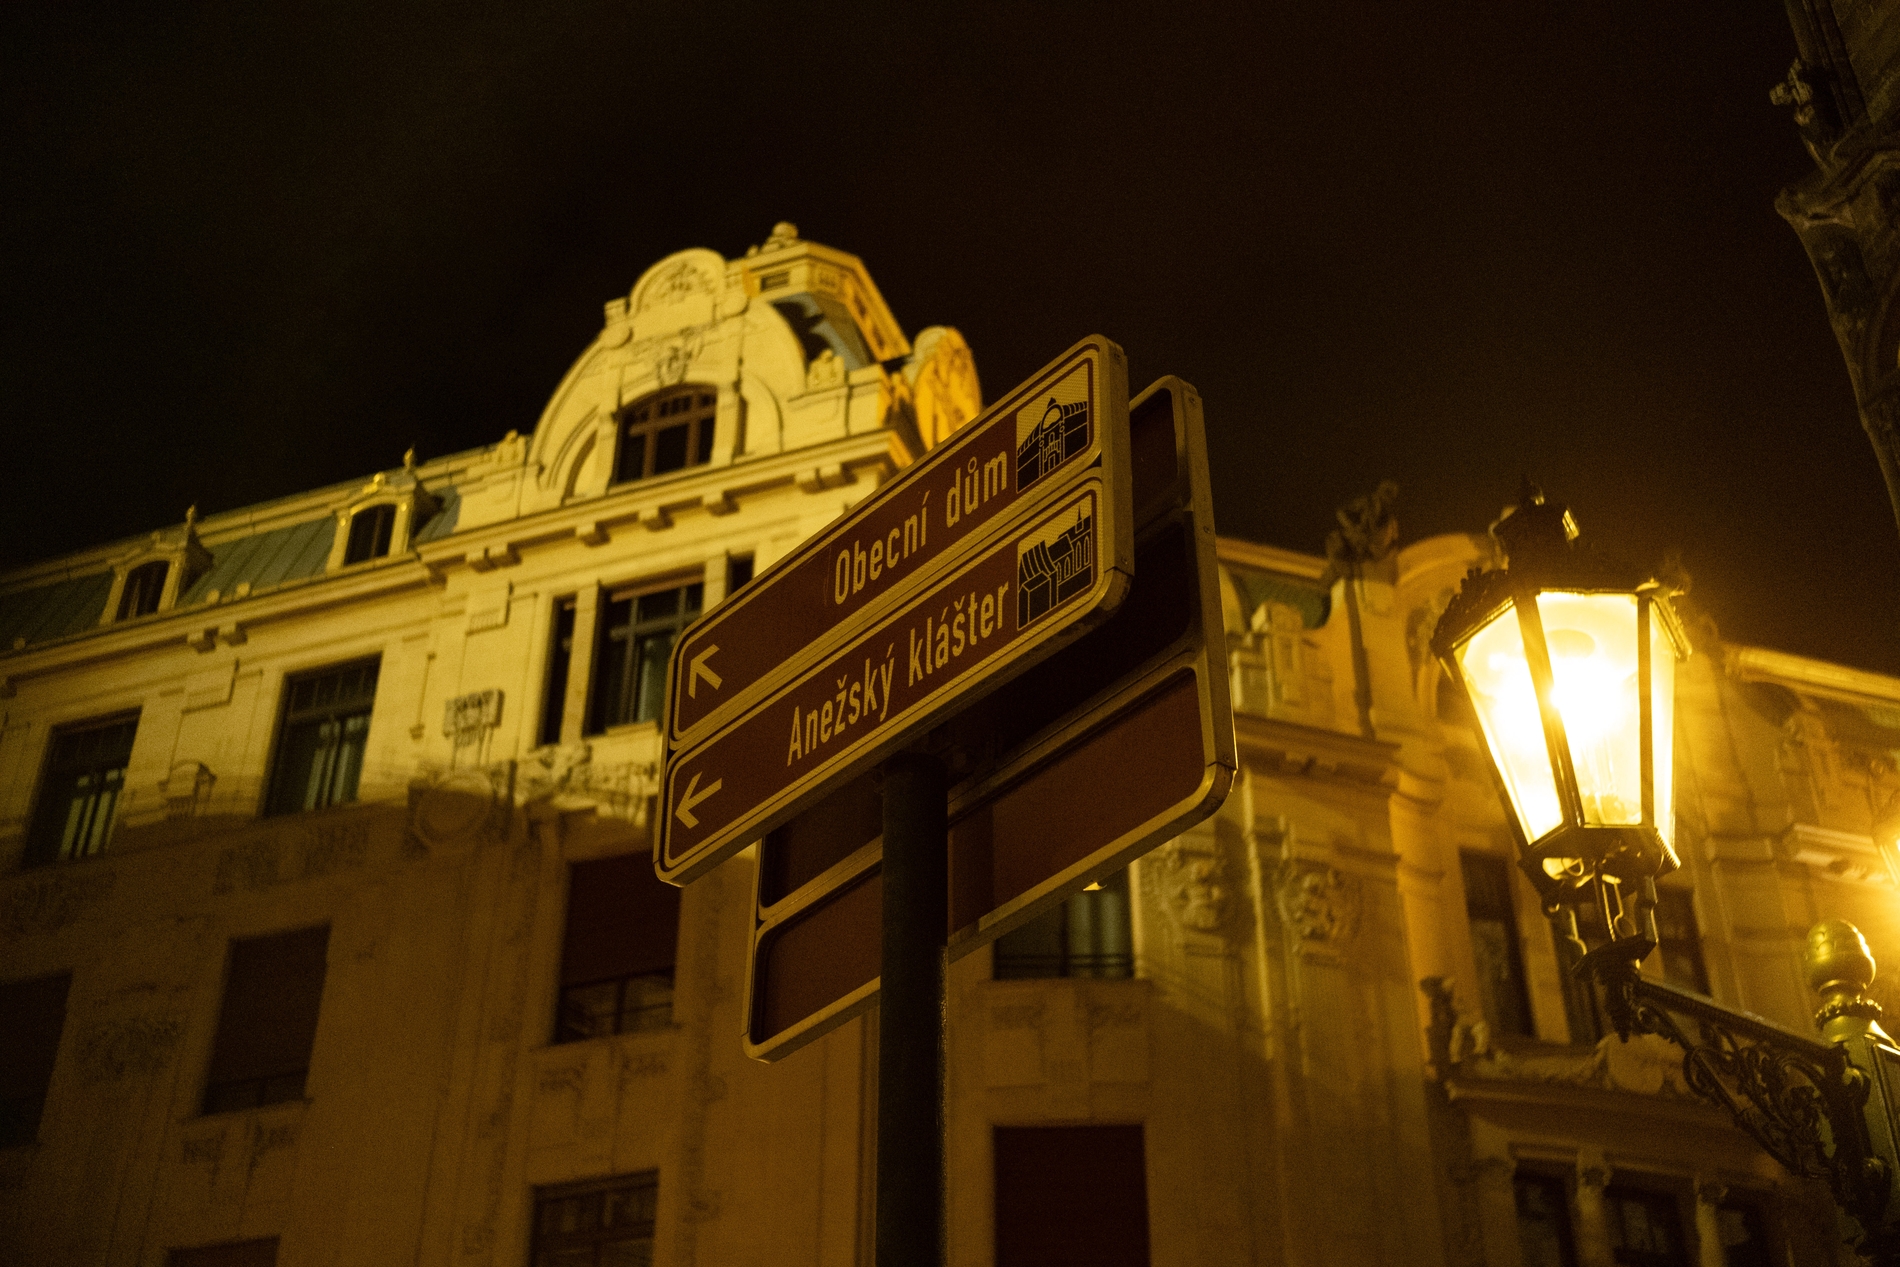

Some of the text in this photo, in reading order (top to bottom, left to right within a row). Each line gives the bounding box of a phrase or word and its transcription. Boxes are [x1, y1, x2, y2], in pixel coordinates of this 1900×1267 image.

[834, 451, 1008, 605] Obecní dům
[787, 581, 1009, 767] Anežský klášter
